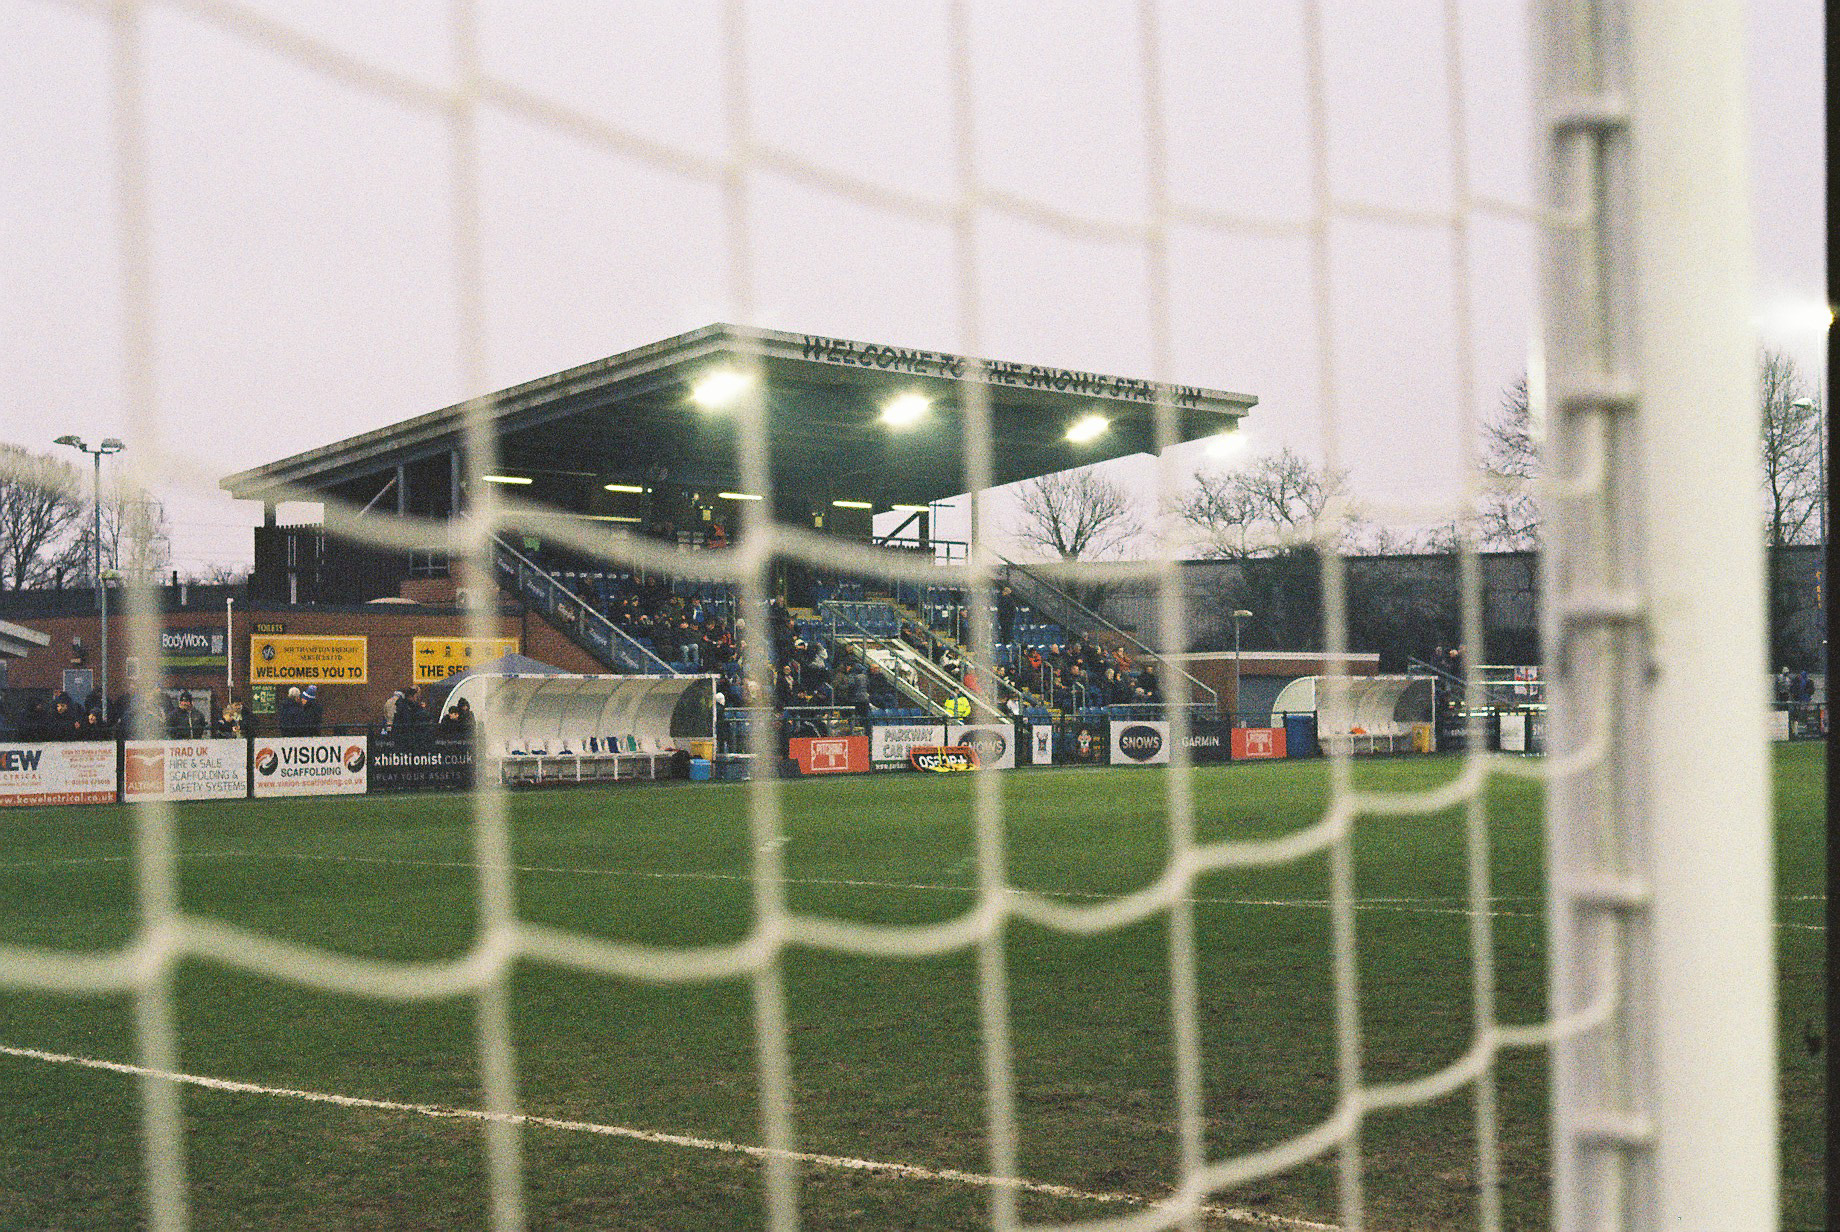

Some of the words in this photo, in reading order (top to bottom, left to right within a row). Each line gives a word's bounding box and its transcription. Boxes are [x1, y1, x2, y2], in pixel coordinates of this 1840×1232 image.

[803, 336, 932, 373] WELCOME
[938, 353, 966, 378] TO
[1024, 366, 1107, 395] SNOWS
[256, 666, 319, 678] WELCOMES
[322, 667, 344, 677] YOU
[348, 667, 362, 677] TO
[419, 664, 444, 677] THE
[884, 728, 934, 742] PARKWAY
[1122, 737, 1159, 749] SNOWS
[1182, 737, 1220, 748] GARMIN
[170, 747, 193, 757] TRAD
[196, 747, 208, 756] UK
[281, 746, 341, 764] VISION
[170, 759, 187, 769] HIRE
[200, 758, 222, 768] SALE
[170, 770, 230, 781] SCAFFOLDING
[281, 767, 341, 777] SCAFFOLDING
[170, 782, 202, 792] SAFETY
[206, 780, 246, 792] SYSTEMS
